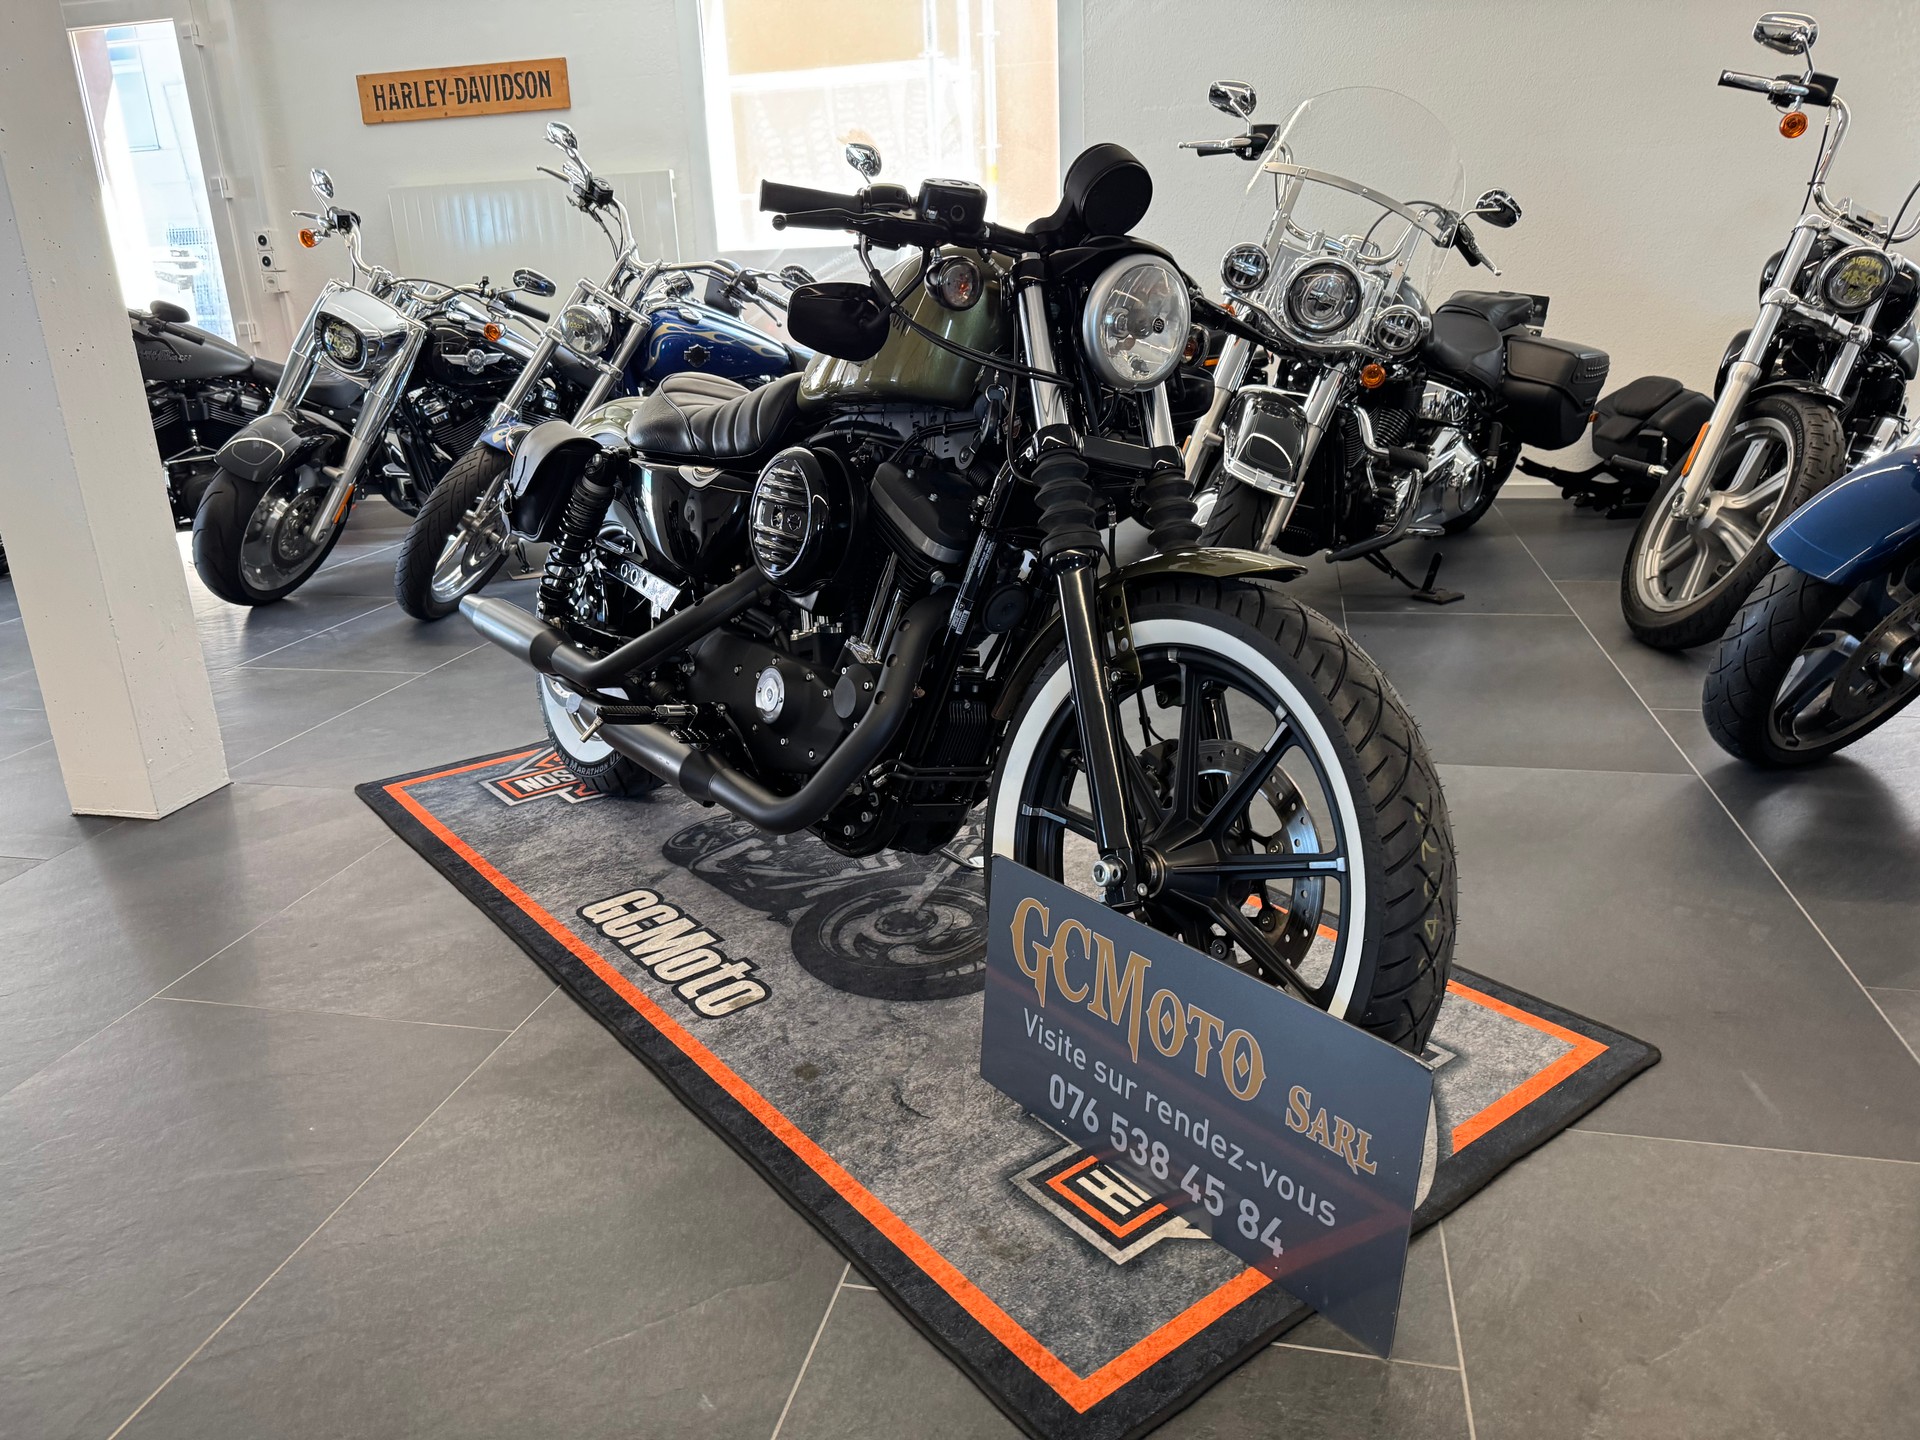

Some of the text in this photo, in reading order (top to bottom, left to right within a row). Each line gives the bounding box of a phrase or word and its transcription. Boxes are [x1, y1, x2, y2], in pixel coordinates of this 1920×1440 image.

[372, 70, 552, 111] HARLEY-DAVIDSON
[581, 889, 767, 1017] GCMoto
[1024, 1008, 1086, 1070] Visite
[1093, 1061, 1137, 1100] sur
[1146, 1091, 1337, 1227] rendez-vous
[1049, 1074, 1099, 1133] 076
[1110, 1112, 1170, 1180] 538
[1181, 1164, 1226, 1217] 45
[1237, 1198, 1284, 1258] 84
